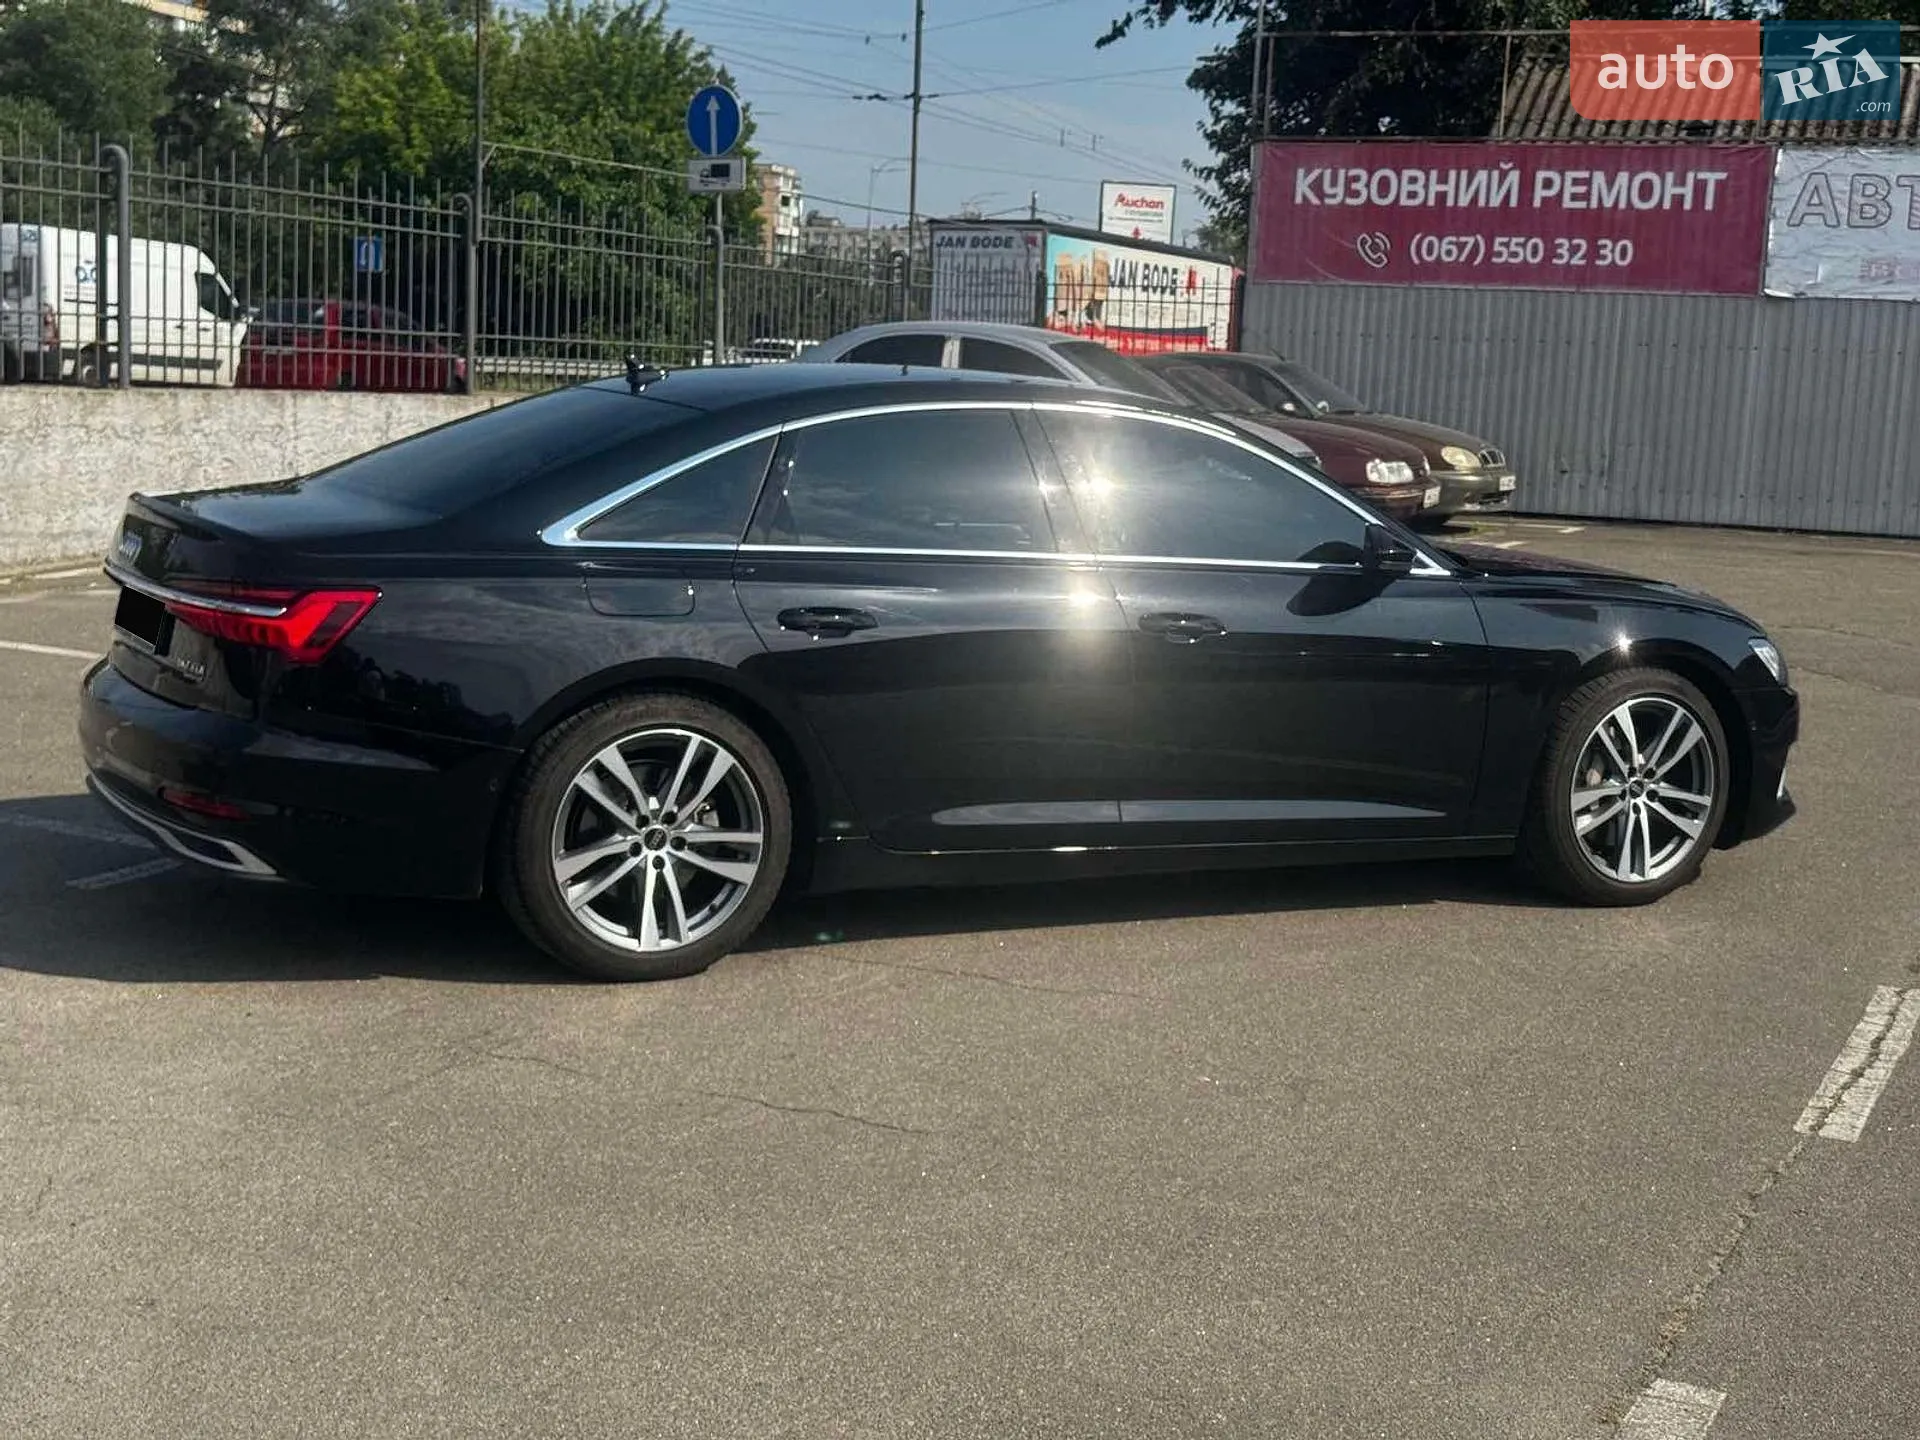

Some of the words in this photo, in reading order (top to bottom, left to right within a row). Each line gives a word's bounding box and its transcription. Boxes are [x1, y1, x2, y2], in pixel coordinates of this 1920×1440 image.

[1114, 193, 1165, 209] Auchan
[1294, 161, 1520, 208] КУЗОВНИЙ
[1532, 169, 1728, 211] РЕМОНТ
[936, 235, 966, 249] JAN
[970, 236, 1015, 249] BODE
[1410, 232, 1485, 265] (067)
[1492, 236, 1544, 264] 550
[1552, 238, 1587, 265] 32
[1595, 239, 1634, 266] 30
[1109, 257, 1139, 290] JAN
[1142, 262, 1179, 297] BODE
